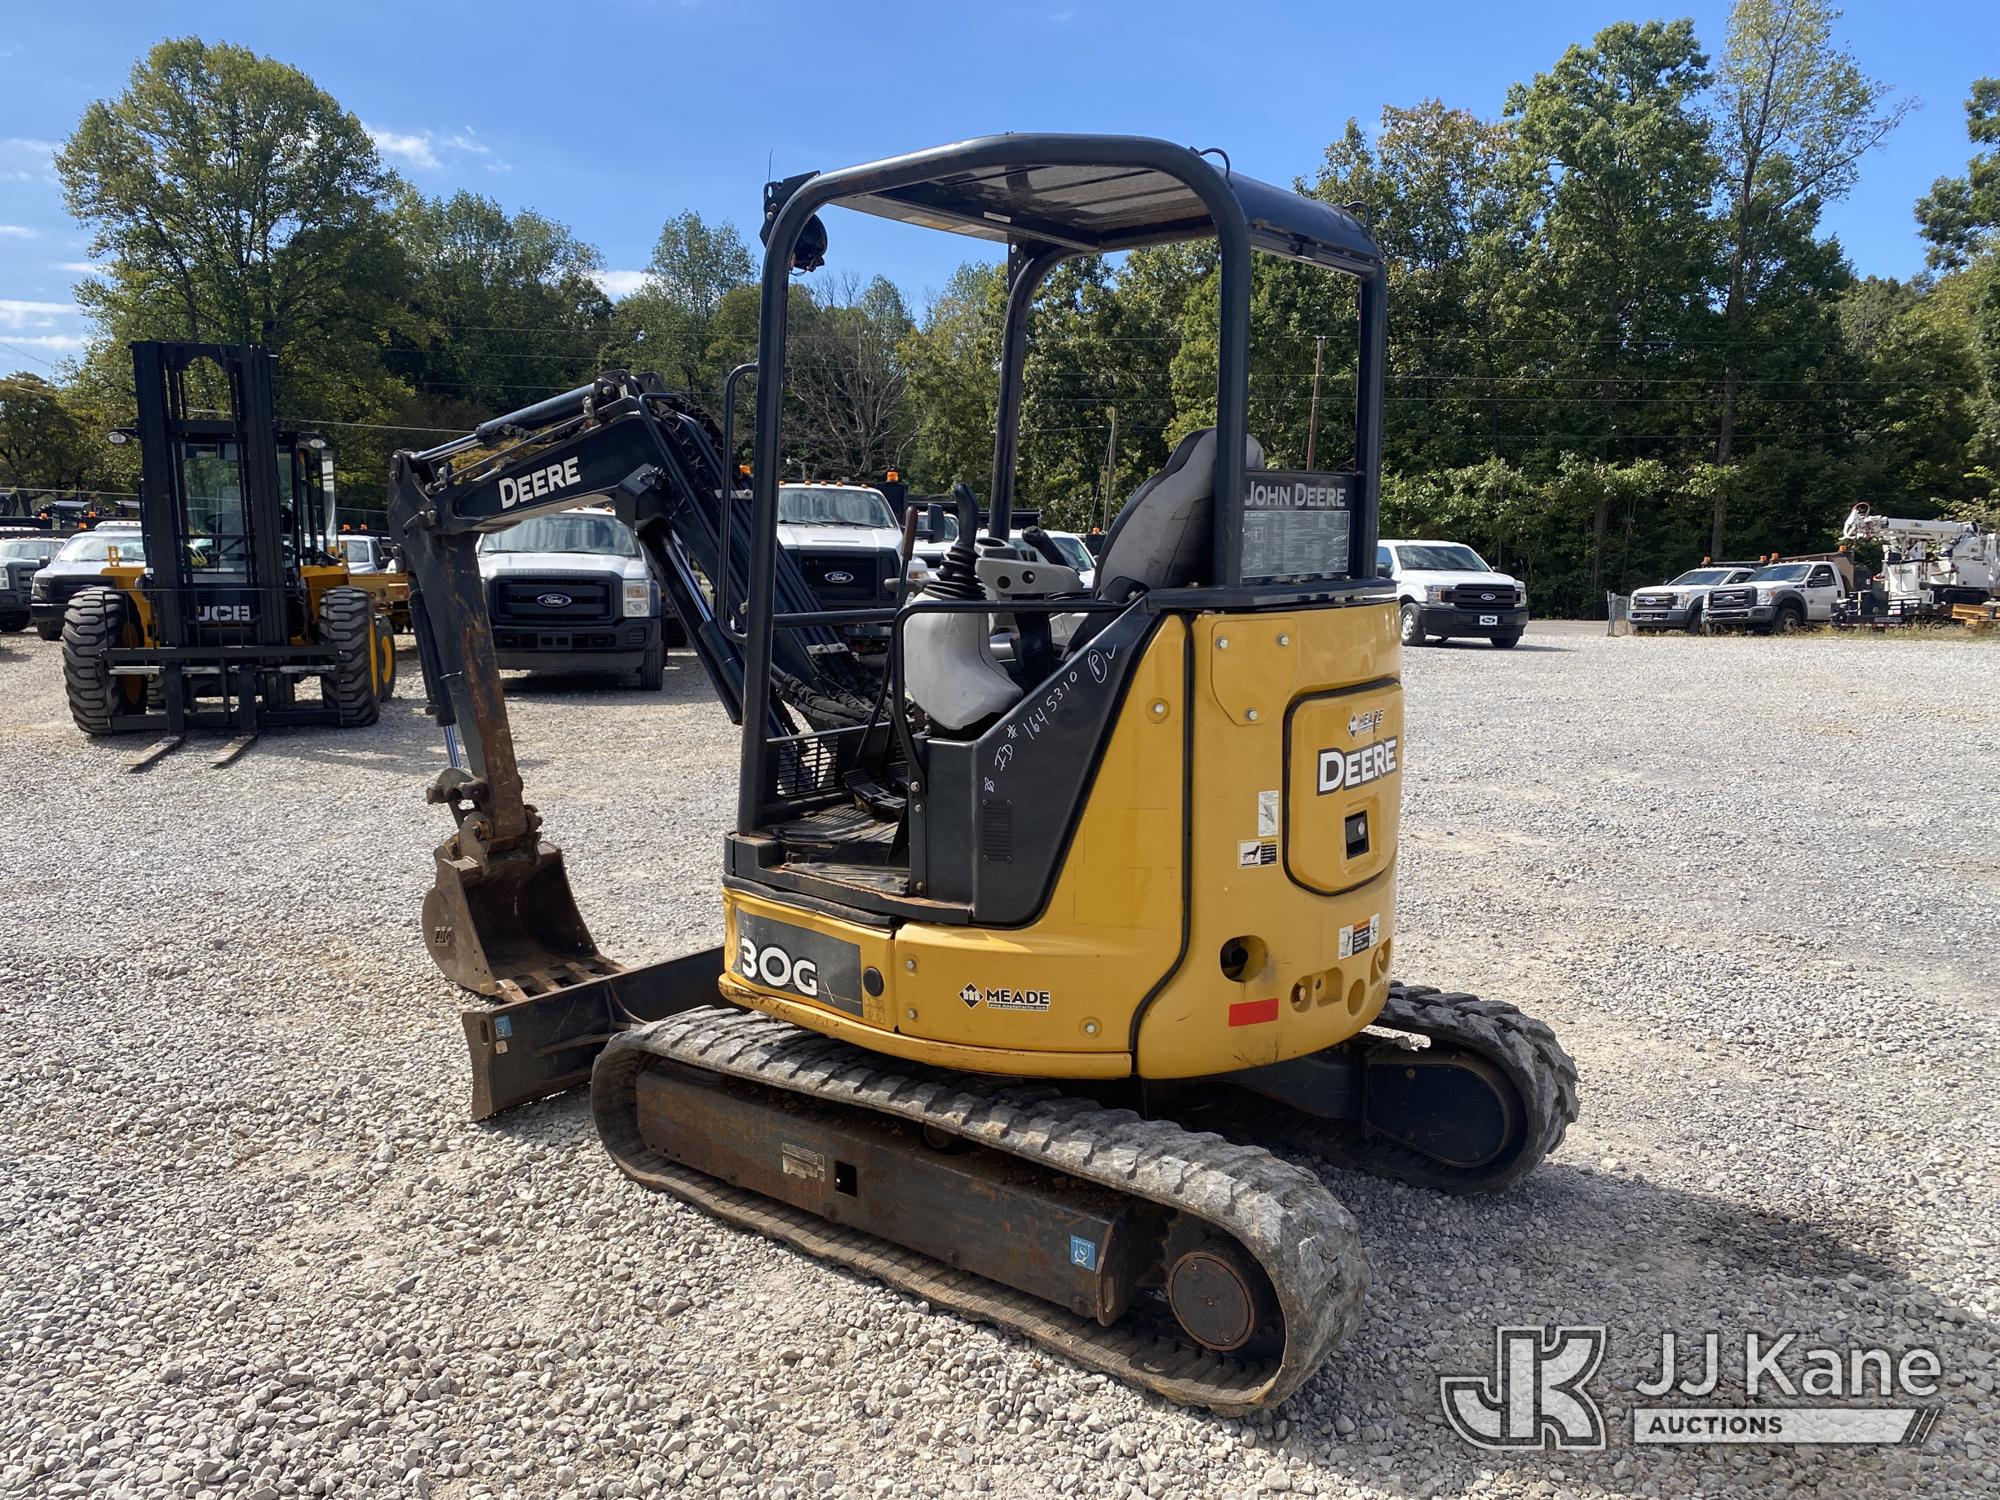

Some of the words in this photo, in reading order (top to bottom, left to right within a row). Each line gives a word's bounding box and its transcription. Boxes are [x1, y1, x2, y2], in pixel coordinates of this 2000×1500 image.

[498, 456, 581, 509] DEERE
[1244, 481, 1291, 506] JOHN
[1294, 483, 1346, 507] DEERE
[198, 605, 251, 621] JCB
[1022, 671, 1078, 740] 1645310
[1319, 738, 1397, 793] DEERE
[741, 937, 818, 996] 30G
[986, 988, 1050, 1005] MEADE
